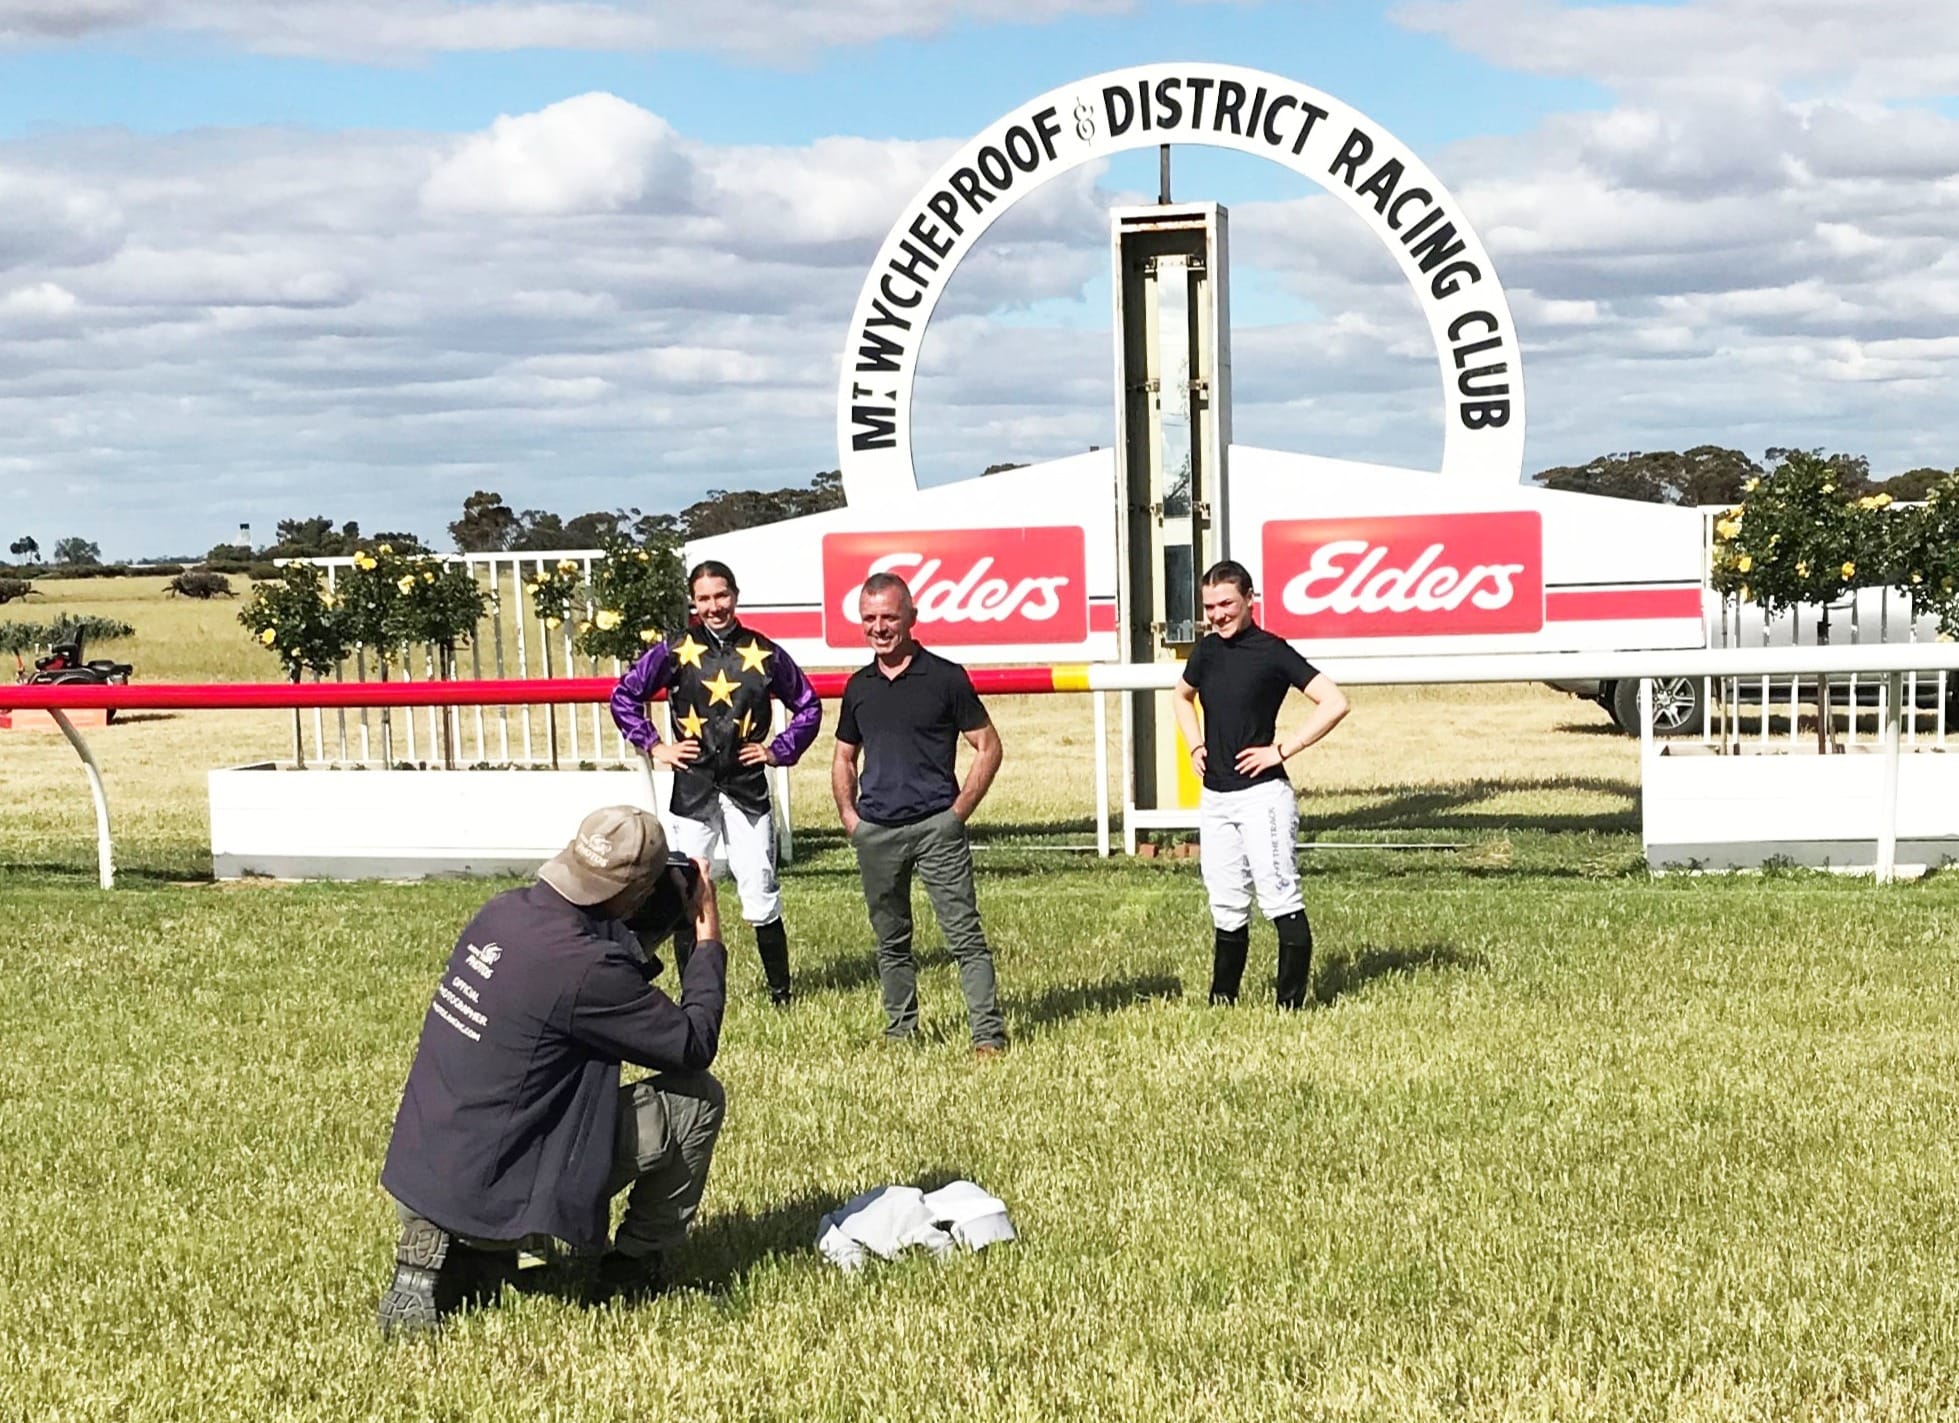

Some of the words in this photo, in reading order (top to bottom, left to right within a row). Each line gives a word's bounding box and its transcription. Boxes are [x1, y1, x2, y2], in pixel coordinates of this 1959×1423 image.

[855, 106, 1062, 371] WYCHEPROOF
[1073, 96, 1095, 147] &
[1102, 77, 1329, 155] DISTRICT
[1327, 127, 1482, 300] RACING
[1447, 310, 1510, 430] CLUB
[1282, 540, 1525, 615] Elders
[465, 954, 494, 979] PHOTOS
[440, 983, 488, 1026] HOTOGRAPHER
[452, 976, 480, 1003] OFFICIAL
